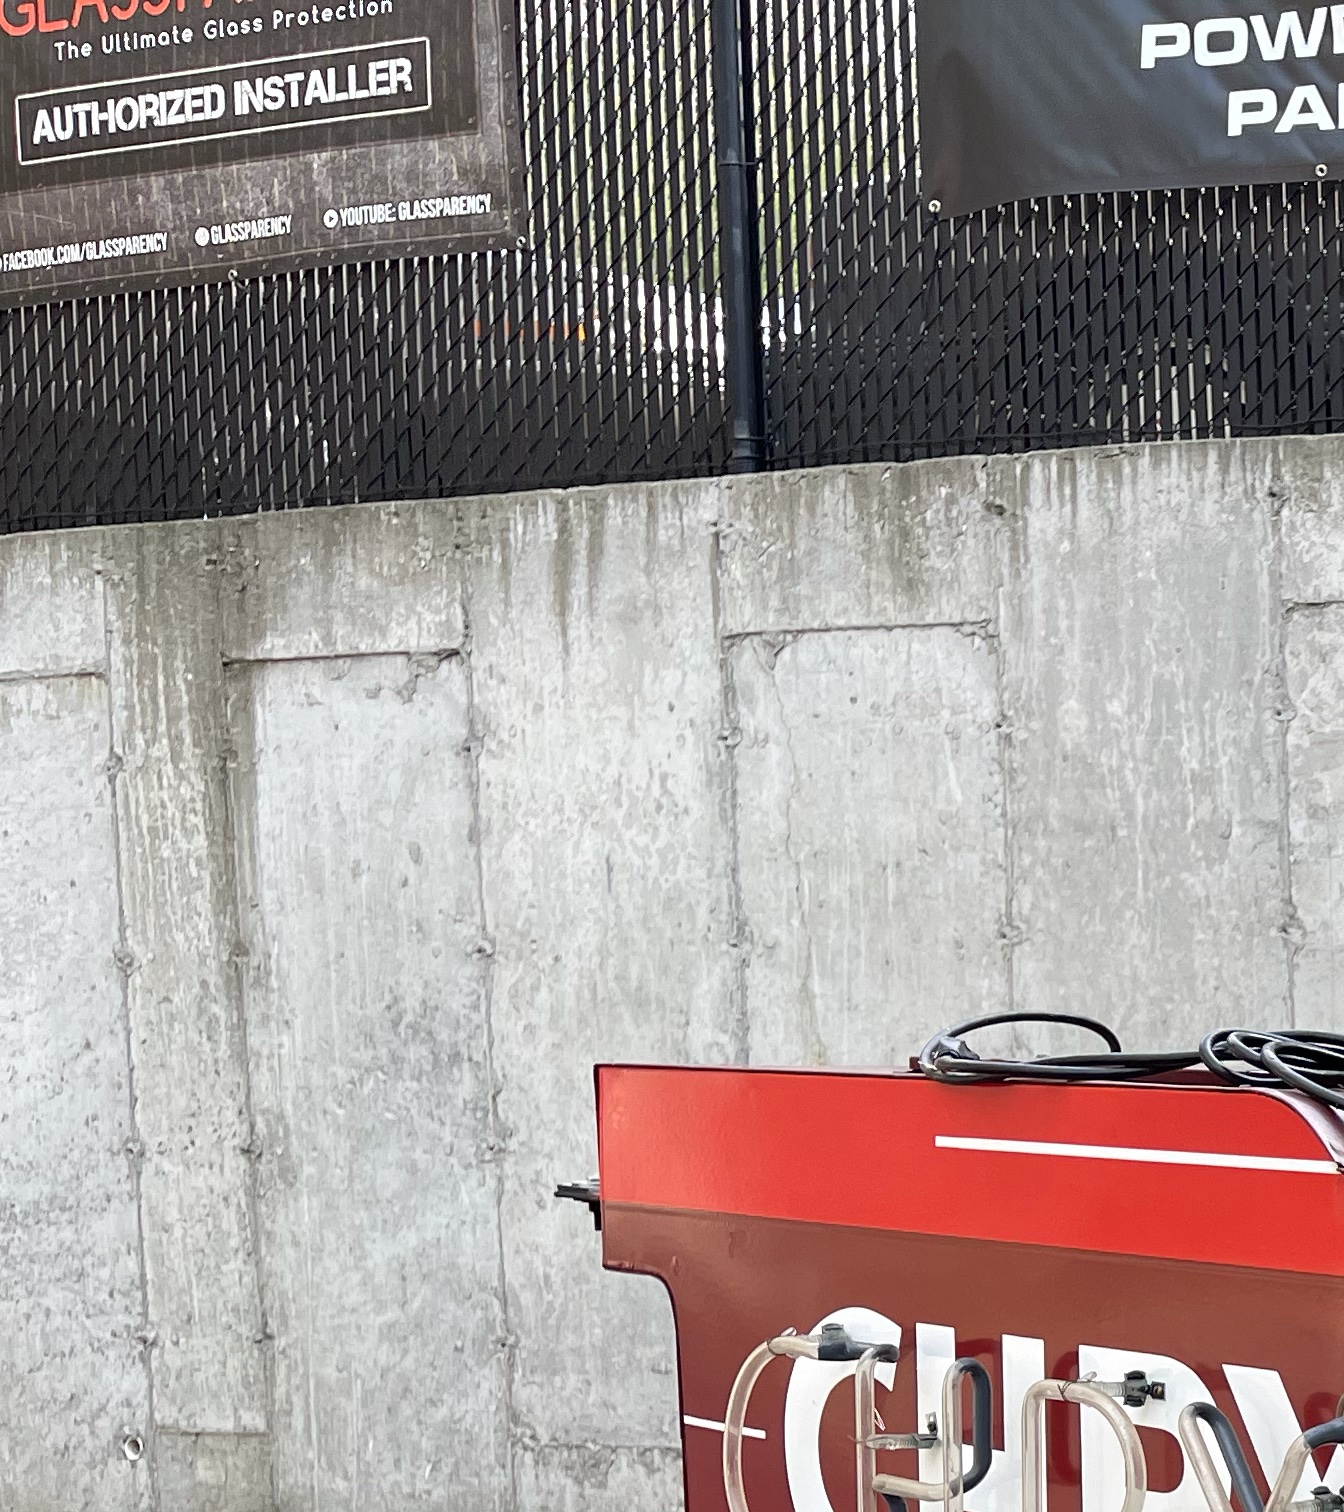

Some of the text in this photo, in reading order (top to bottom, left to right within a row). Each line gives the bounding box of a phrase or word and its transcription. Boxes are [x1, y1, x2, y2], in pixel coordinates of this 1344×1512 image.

[54, 41, 92, 61] The
[101, 25, 194, 54] Ultimate
[203, 17, 263, 40] Glass
[273, 0, 393, 30] Protection
[33, 57, 413, 145] AUTHORIZED INSTALLER
[211, 214, 292, 245] GLASSPARENCY
[340, 193, 492, 227] YOUTUBE: GLASSPARENCY
[3, 232, 168, 272] FACEBOOK.COM/GLASSPARENCY
